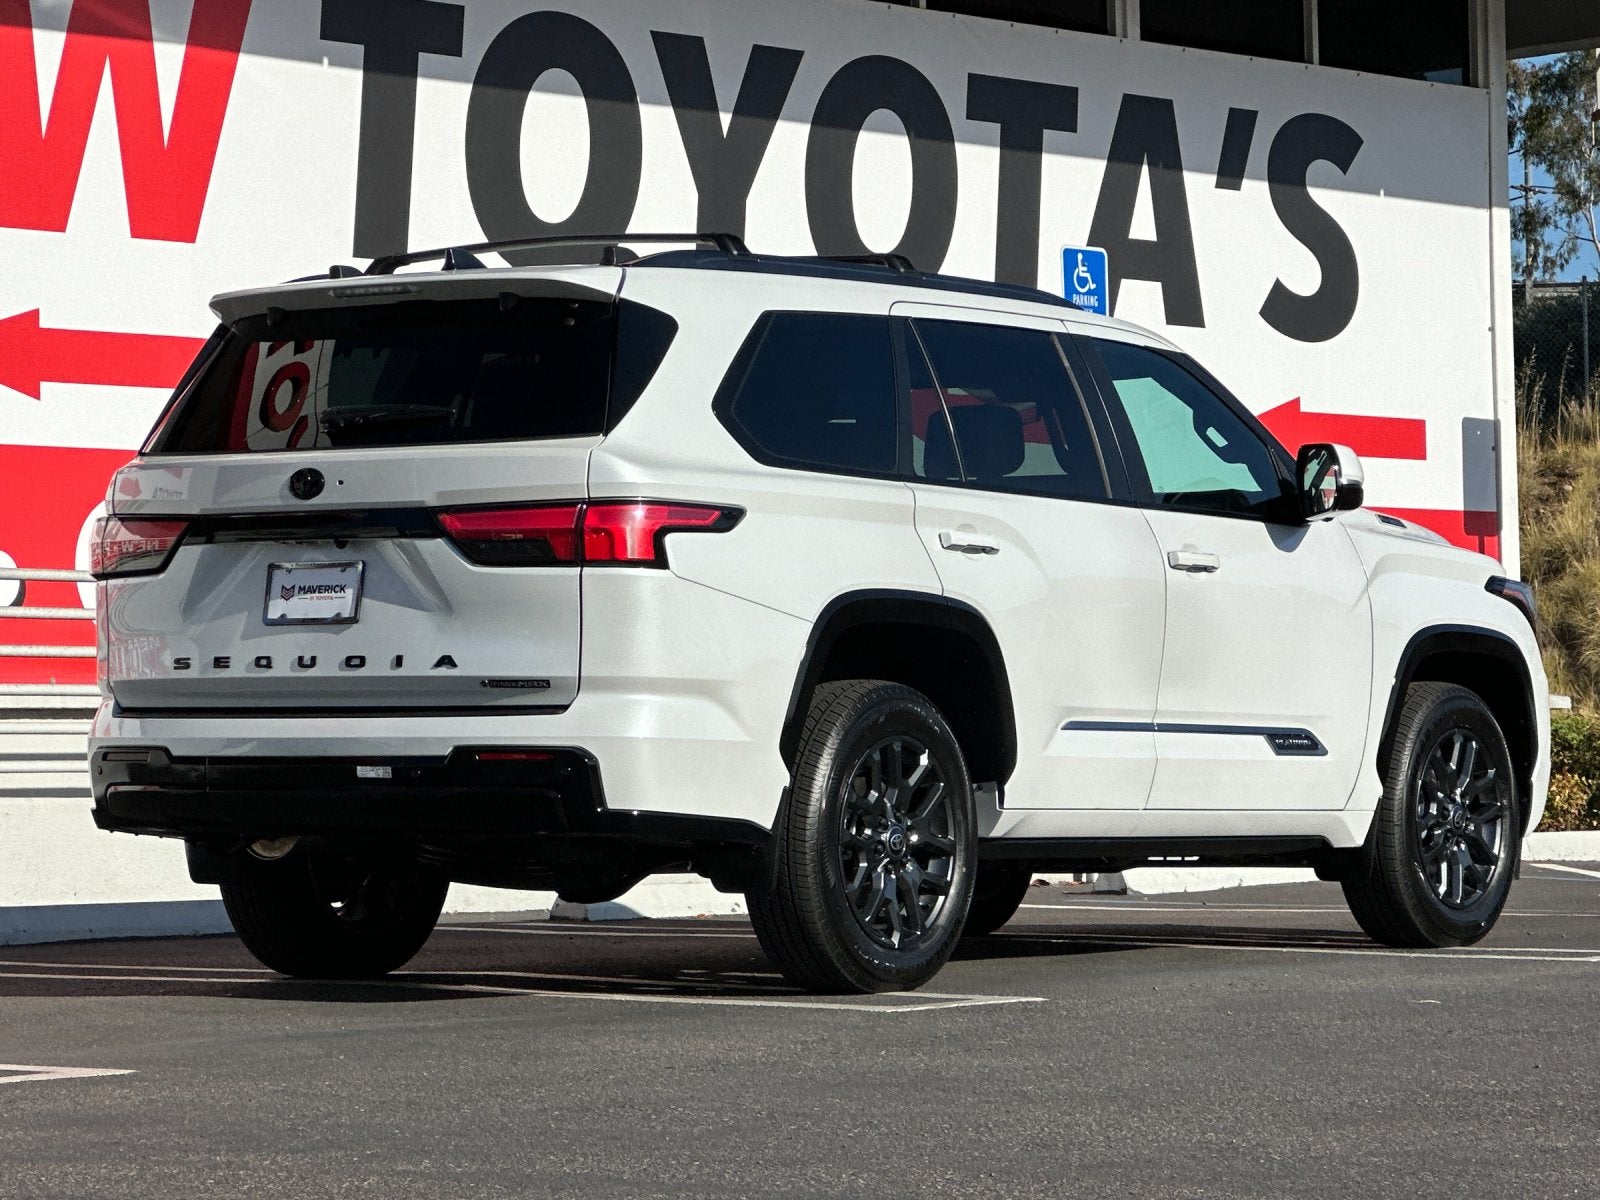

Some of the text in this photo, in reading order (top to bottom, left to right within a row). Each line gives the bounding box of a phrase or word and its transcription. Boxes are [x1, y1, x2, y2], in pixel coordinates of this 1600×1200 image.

[320, 0, 1364, 343] TOYOTA'S
[1072, 293, 1099, 307] PARKING
[298, 584, 347, 595] MAVERICK
[173, 654, 459, 671] SEQUOIA
